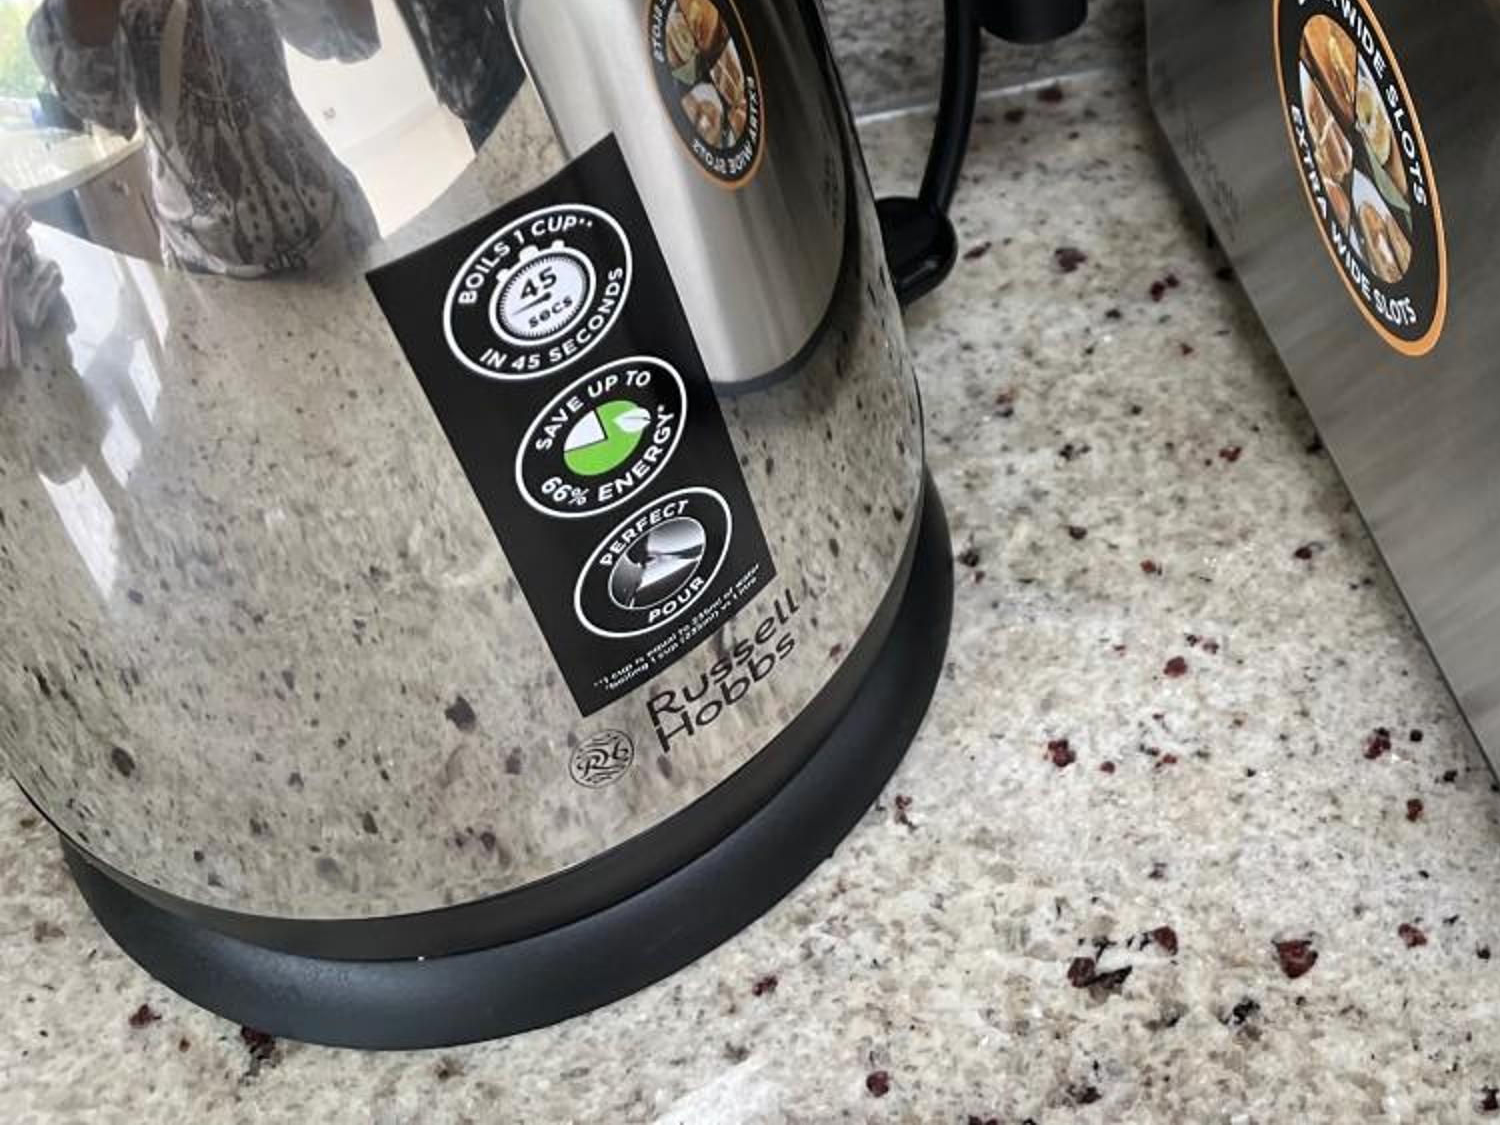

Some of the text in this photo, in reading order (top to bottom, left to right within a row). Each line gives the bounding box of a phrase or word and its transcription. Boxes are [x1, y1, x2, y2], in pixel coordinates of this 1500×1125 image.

[1385, 84, 1428, 207] SLOTS
[1291, 105, 1418, 327] EXTRA WIDE SLOTS
[458, 240, 511, 305] BOILS
[512, 229, 526, 244] 1
[519, 266, 558, 300] 45
[479, 267, 624, 370] IN 45 SECONDS
[528, 295, 574, 329] secs
[535, 370, 652, 451] SAVE UP TO
[541, 475, 590, 506] 66%
[599, 499, 690, 566] PERFECT
[648, 576, 706, 623] POUR
[645, 587, 800, 727] Russell
[655, 632, 797, 754] Hobbs
